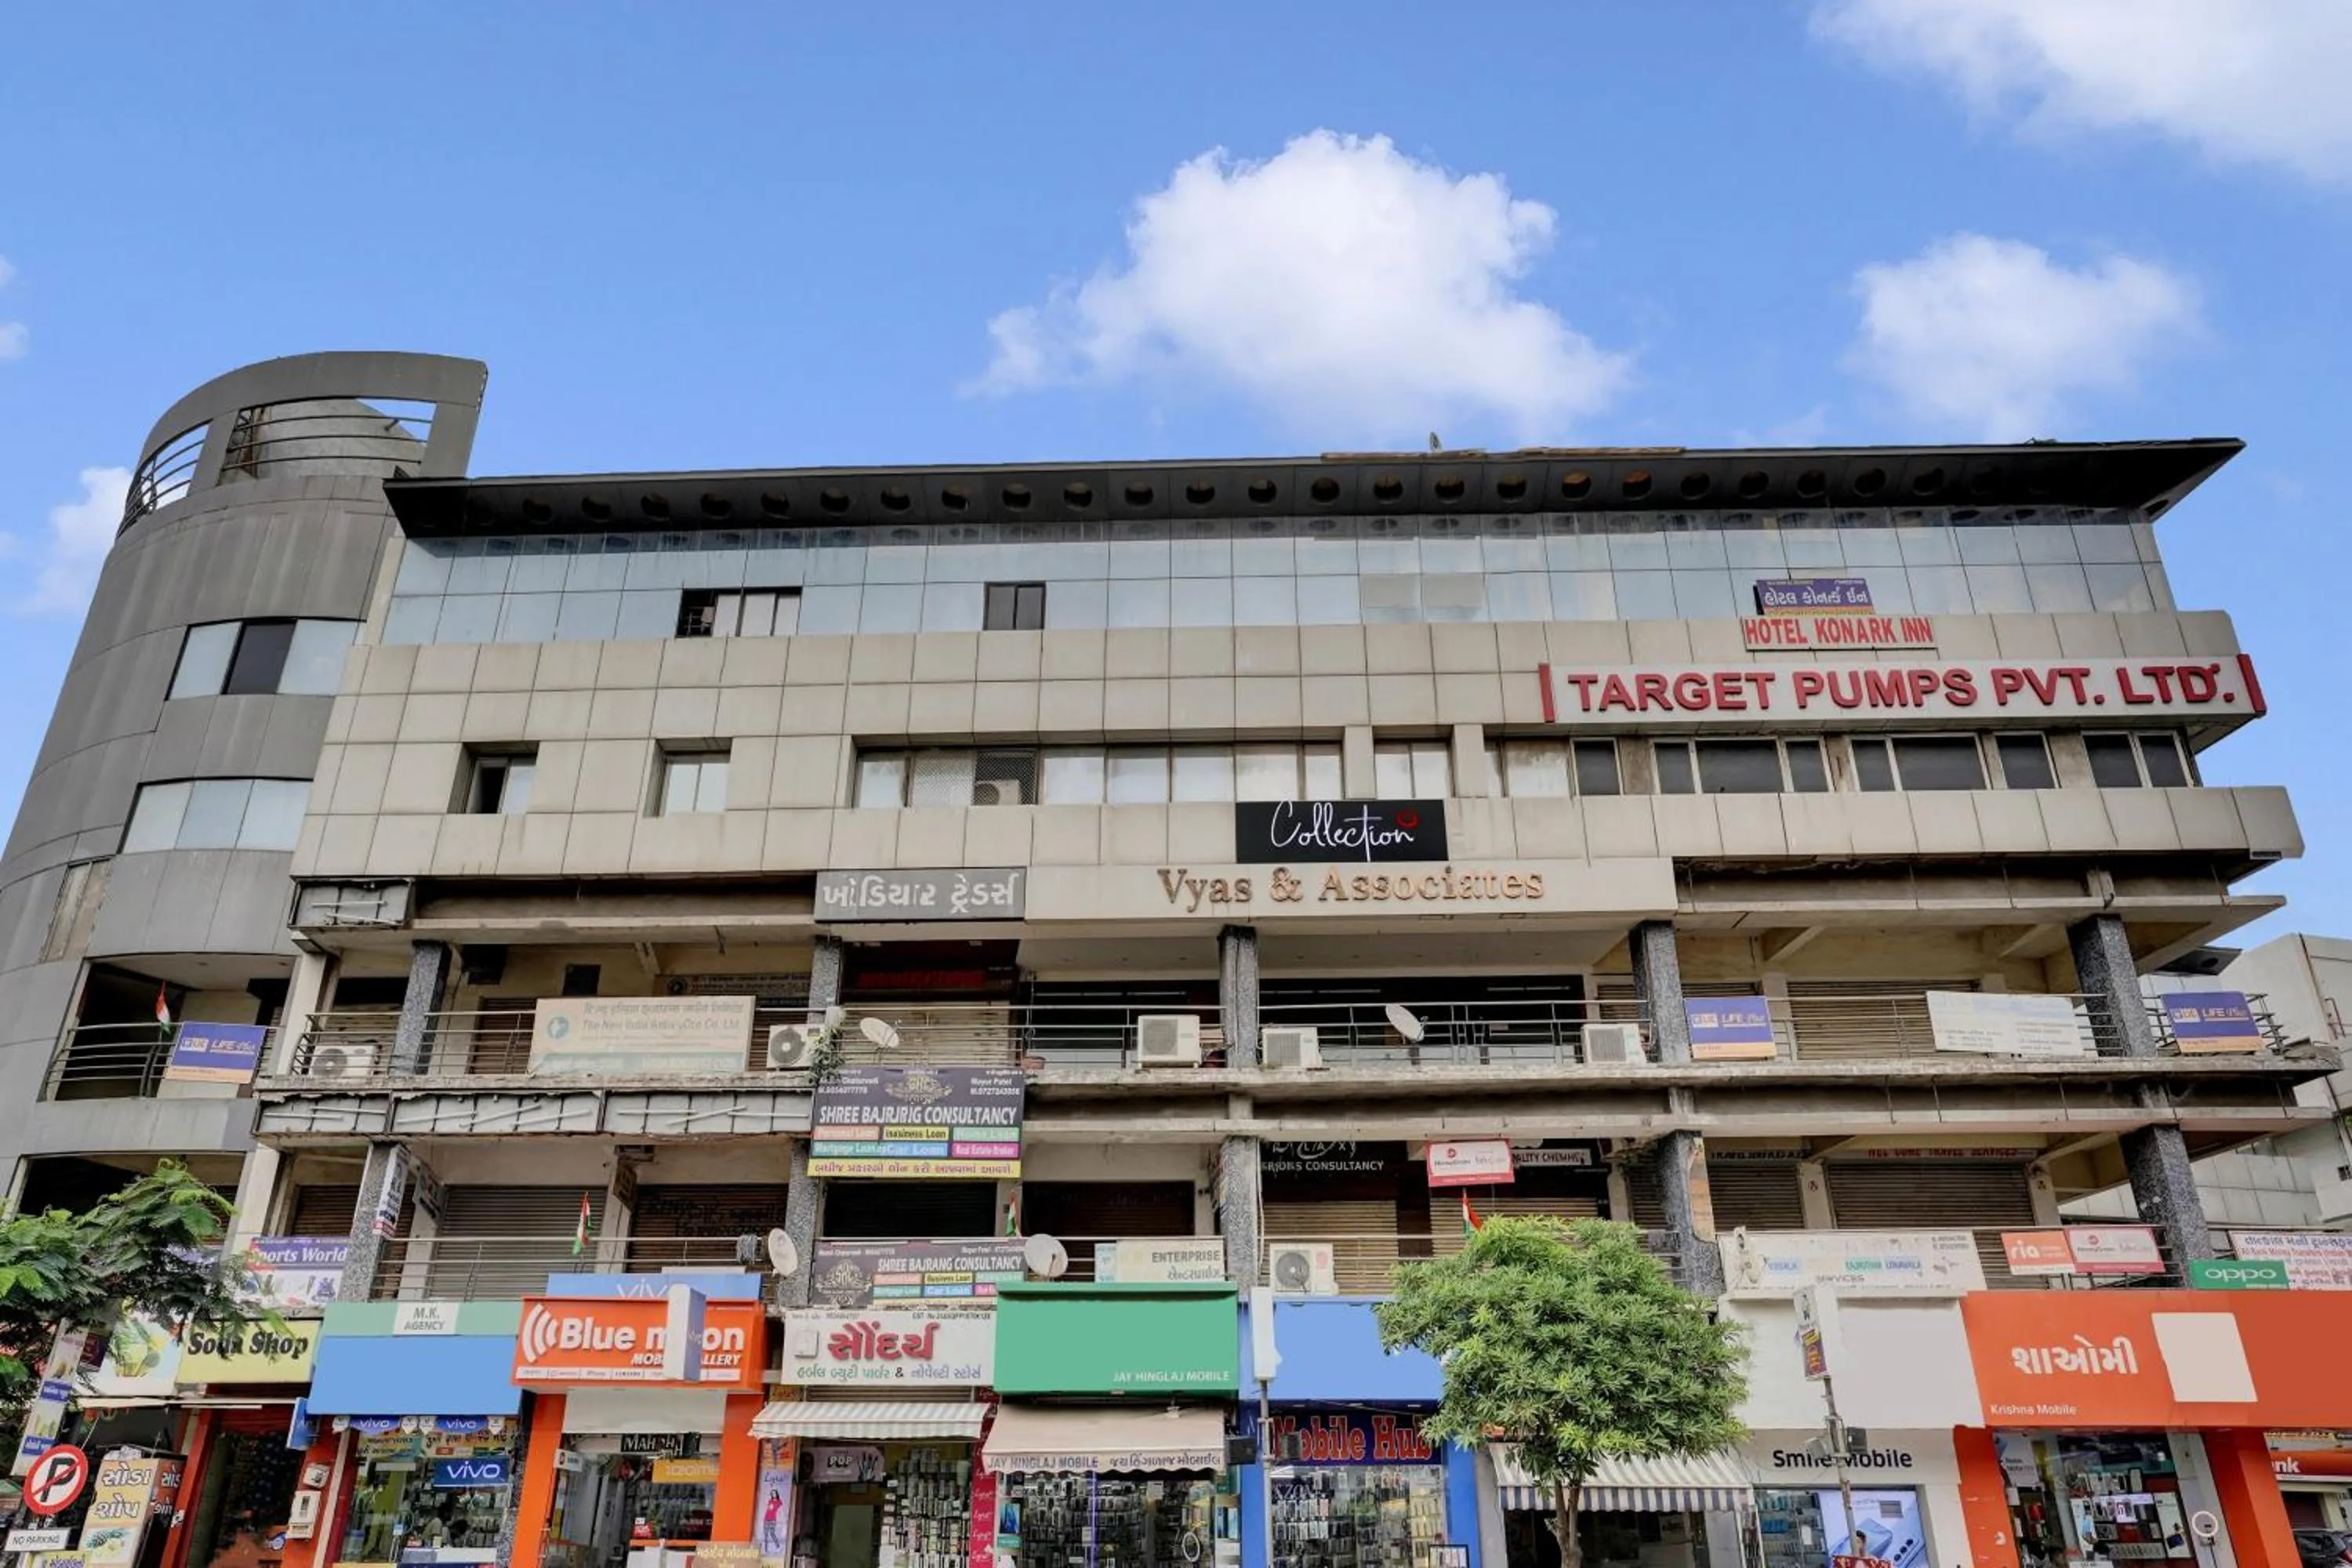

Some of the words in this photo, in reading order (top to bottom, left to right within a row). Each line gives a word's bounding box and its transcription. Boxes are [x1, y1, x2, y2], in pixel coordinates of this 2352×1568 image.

[1744, 618, 1808, 644] HOTEL
[1814, 617, 1897, 644] KONARK
[1900, 617, 1934, 643] INN
[1568, 670, 1776, 712] TARGET
[1793, 667, 1979, 709] PUMPS
[1994, 666, 2104, 706] PVT.
[2116, 662, 2234, 704] LTD.
[1271, 800, 1416, 862] Collection
[823, 873, 936, 911] ખોડિયાર
[1158, 867, 1253, 913] Vyas
[1269, 866, 1304, 902] &
[1319, 863, 1544, 900] Associates
[819, 1105, 860, 1124] SHREE
[924, 1105, 1018, 1125] CONSULTANCY
[1305, 1160, 1385, 1171] CONSULTANCY
[302, 1247, 349, 1262] World
[1152, 1250, 1221, 1263] ENTERPRISE
[877, 1258, 907, 1272] SHREE
[909, 1257, 953, 1272] BAJRANG
[954, 1256, 1022, 1271] CONSULTANCY
[616, 1278, 669, 1298] viv
[413, 1307, 440, 1319] M.K.
[404, 1321, 445, 1330] AGENCY
[559, 1316, 637, 1351] Blue
[644, 1326, 745, 1352] mon
[249, 1332, 309, 1359] Shop
[2010, 1334, 2140, 1374] શાઓમી
[895, 1367, 905, 1378] &
[1112, 1371, 1133, 1382] JAY
[1136, 1371, 1183, 1382] HINGLAJ
[1186, 1370, 1230, 1381] MOBILE
[1990, 1403, 2035, 1415] Krishna
[2037, 1403, 2078, 1415] Mobile
[360, 1417, 390, 1428] vivo
[445, 1418, 477, 1429] vivo
[1271, 1414, 1367, 1462] Mobile
[1372, 1414, 1433, 1461] Hub
[446, 1461, 501, 1479] vivo
[987, 1456, 1007, 1468] JAY
[1010, 1456, 1056, 1468] HINGLAJ
[1058, 1456, 1098, 1468] MOBILE
[102, 1462, 154, 1487] સોડા
[96, 1492, 141, 1519] શોપ
[13, 1534, 25, 1544] NO
[26, 1534, 60, 1544] PARKING
